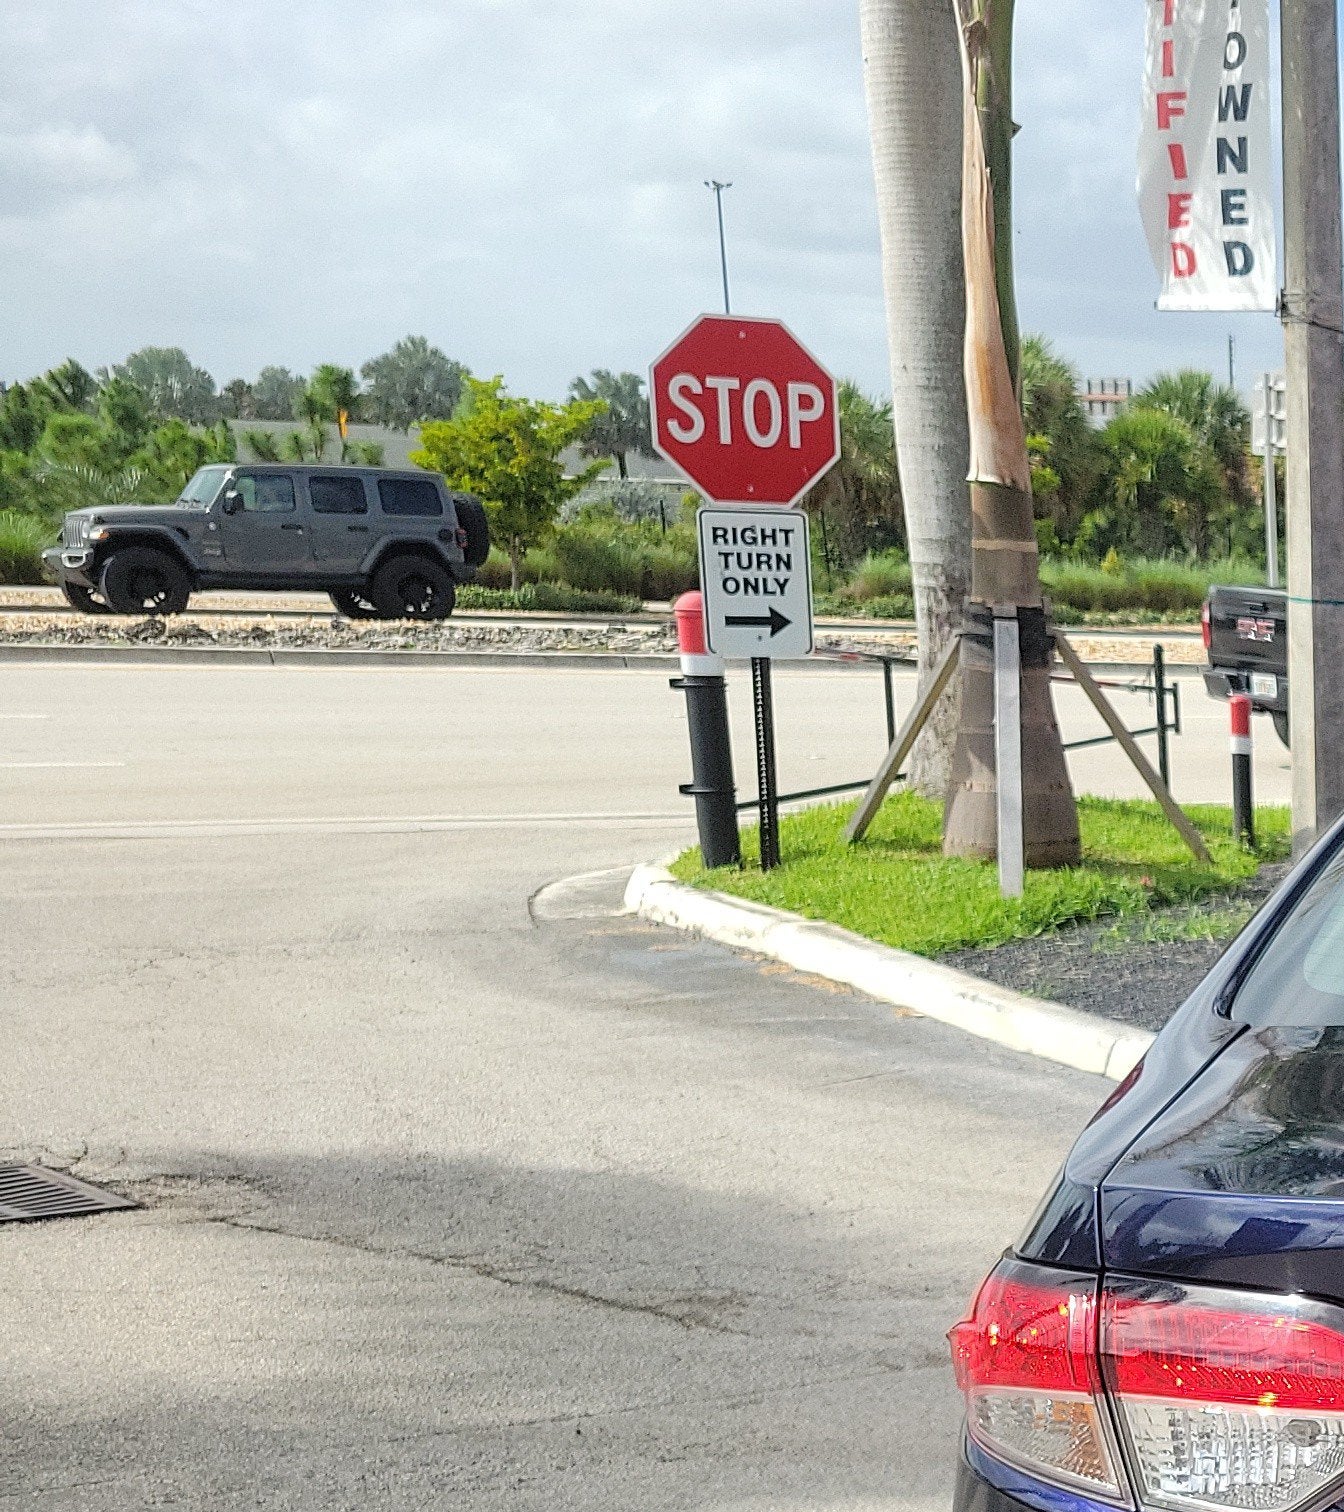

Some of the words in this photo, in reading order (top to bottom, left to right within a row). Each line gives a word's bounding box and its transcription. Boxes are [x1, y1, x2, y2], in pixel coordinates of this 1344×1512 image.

[666, 373, 825, 449] STOP
[711, 525, 794, 547] RIGHT
[718, 551, 792, 571] TURN
[722, 576, 790, 596] ONLY
